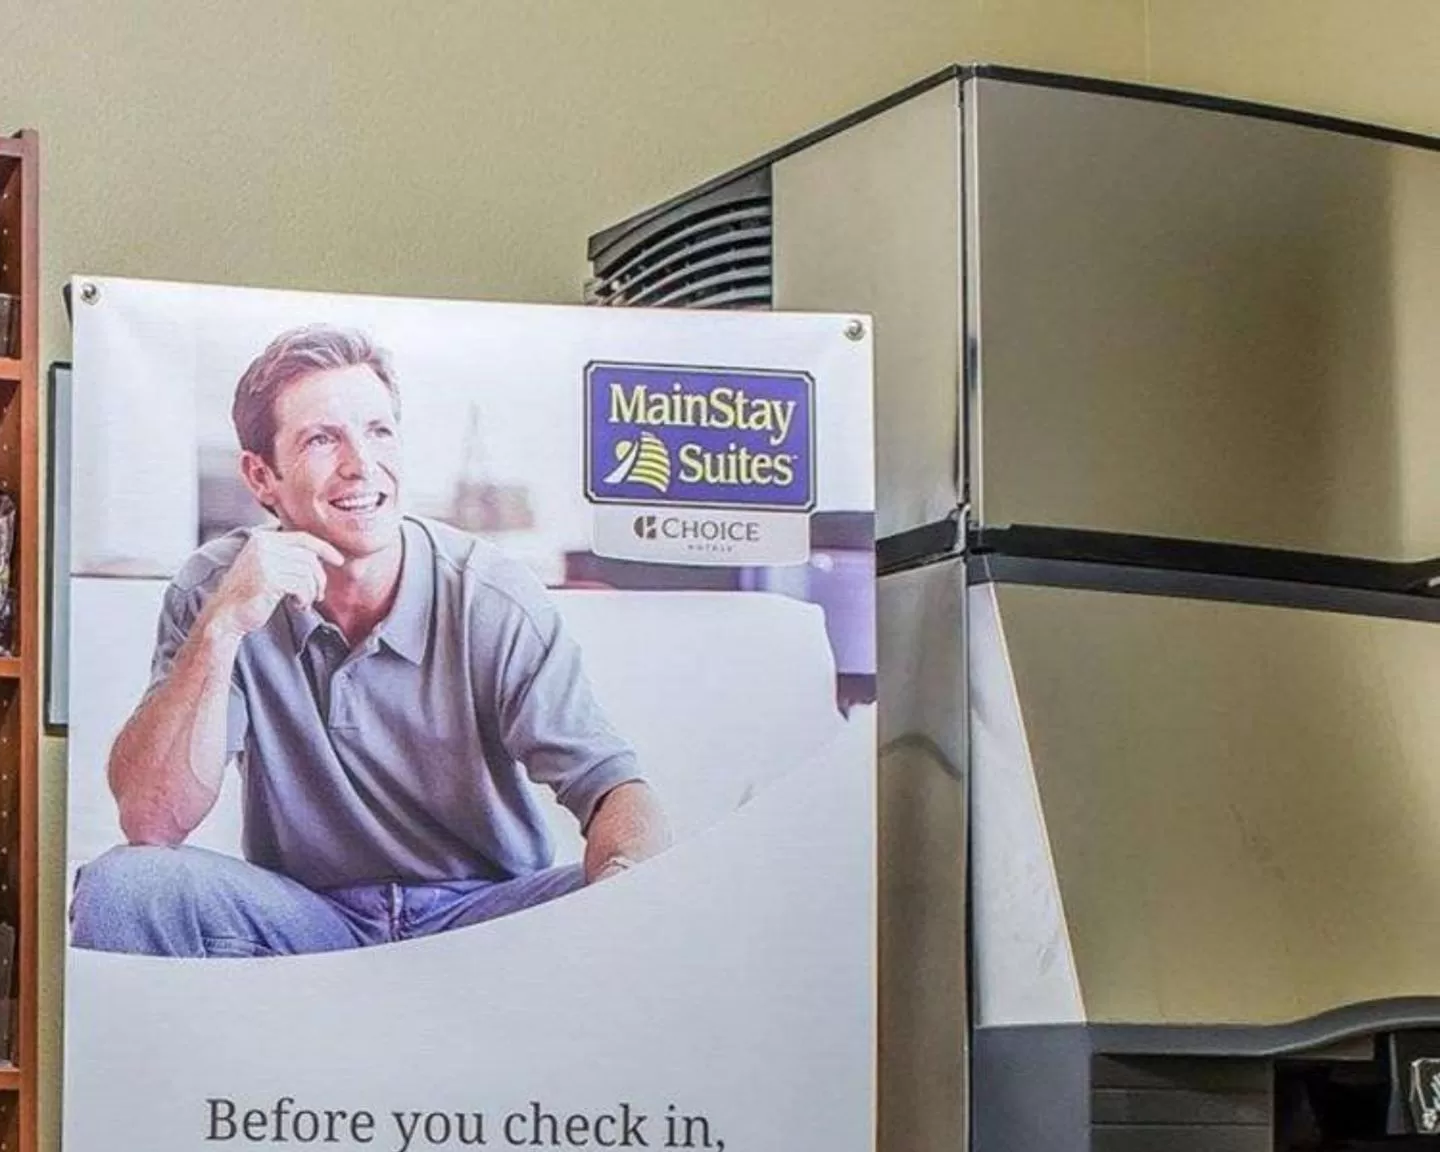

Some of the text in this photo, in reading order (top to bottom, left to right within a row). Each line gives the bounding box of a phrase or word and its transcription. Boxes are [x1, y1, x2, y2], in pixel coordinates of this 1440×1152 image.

[607, 382, 797, 446] MainStay
[678, 443, 794, 486] Suites
[660, 517, 761, 542] CHOICE
[206, 1098, 375, 1143] Before
[503, 1102, 648, 1148] check
